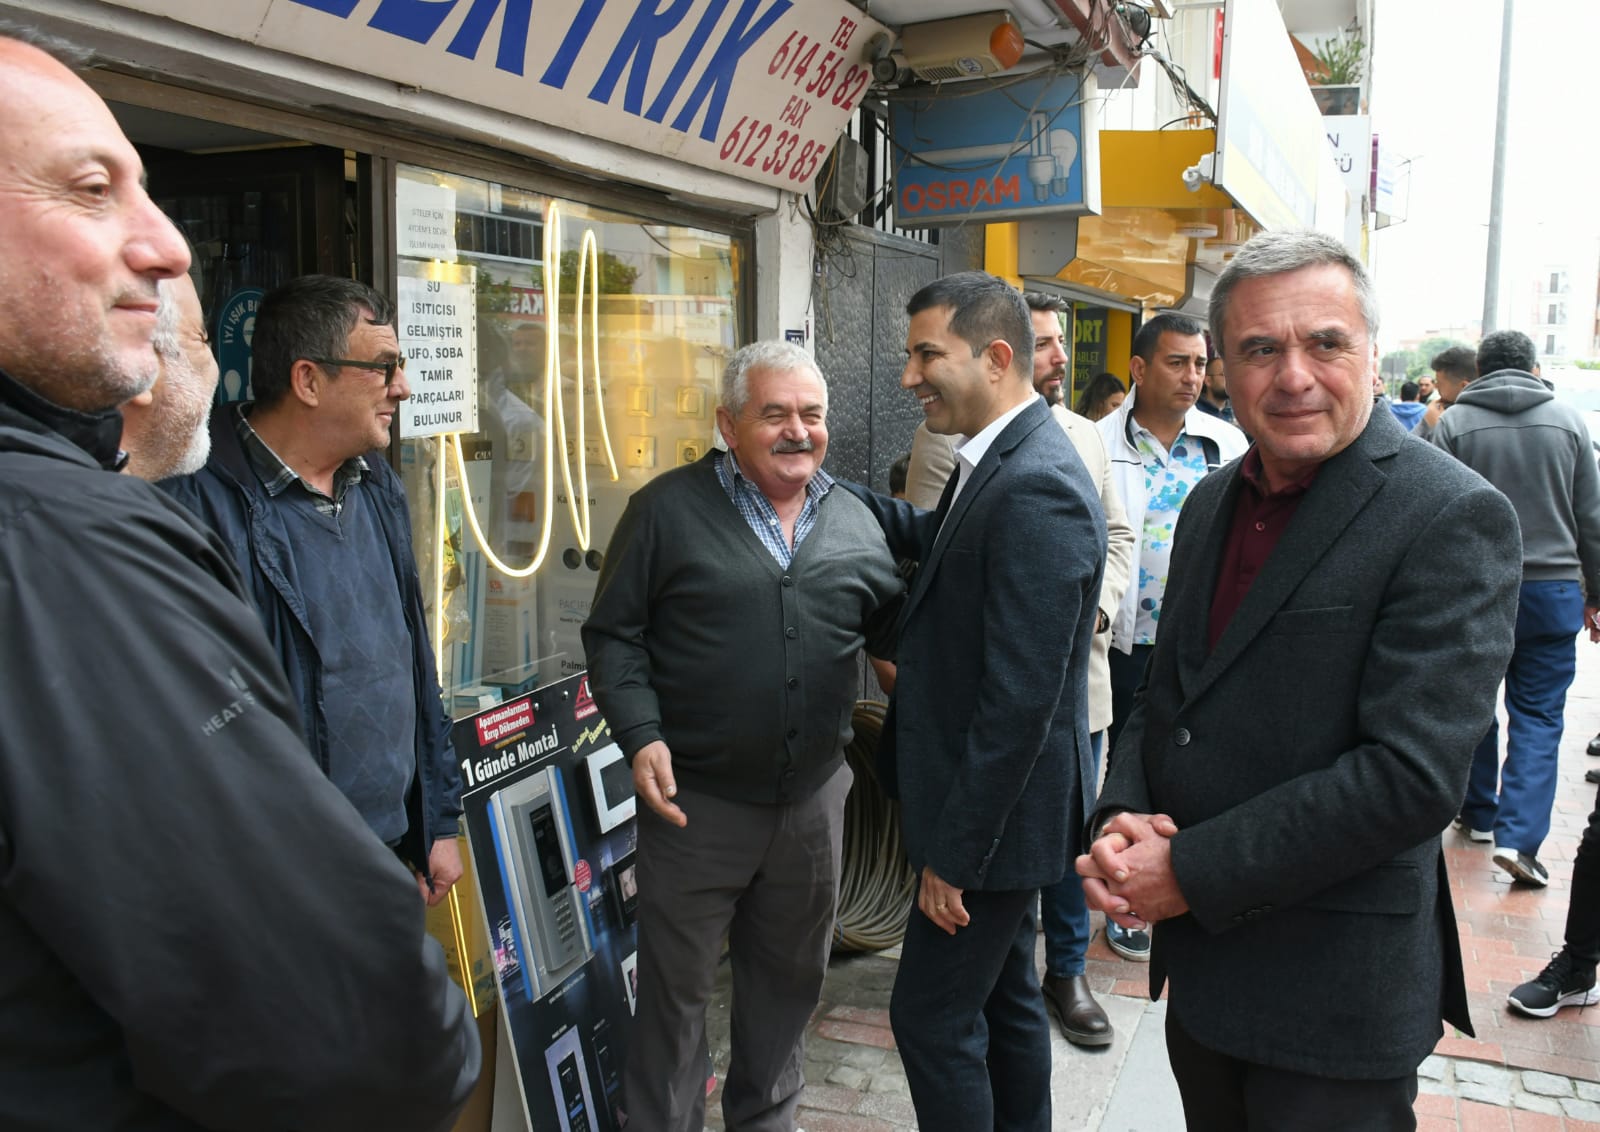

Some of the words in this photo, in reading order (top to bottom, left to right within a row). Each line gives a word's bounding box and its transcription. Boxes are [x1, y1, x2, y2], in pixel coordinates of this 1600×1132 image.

[830, 16, 858, 51] TEL
[767, 30, 820, 86] 614
[805, 50, 845, 98] 56
[831, 64, 869, 111] 82
[779, 95, 812, 129] FAX
[719, 115, 773, 171] 612
[762, 130, 793, 175] 33
[788, 139, 827, 183] 85
[902, 175, 1021, 213] OSRAM
[427, 281, 440, 293] SU
[412, 302, 456, 316] ISITICISI
[407, 324, 463, 341] GELMİŞTİR
[408, 347, 433, 361] UFO,
[435, 347, 464, 359] SOBA
[420, 367, 453, 382] TAMİR
[410, 390, 464, 407] PARÇALARI
[413, 411, 462, 427] BULUNUR
[201, 700, 244, 736] HEAT
[461, 758, 475, 787] 1
[475, 752, 516, 782] Günde
[516, 723, 559, 762] Montaj
